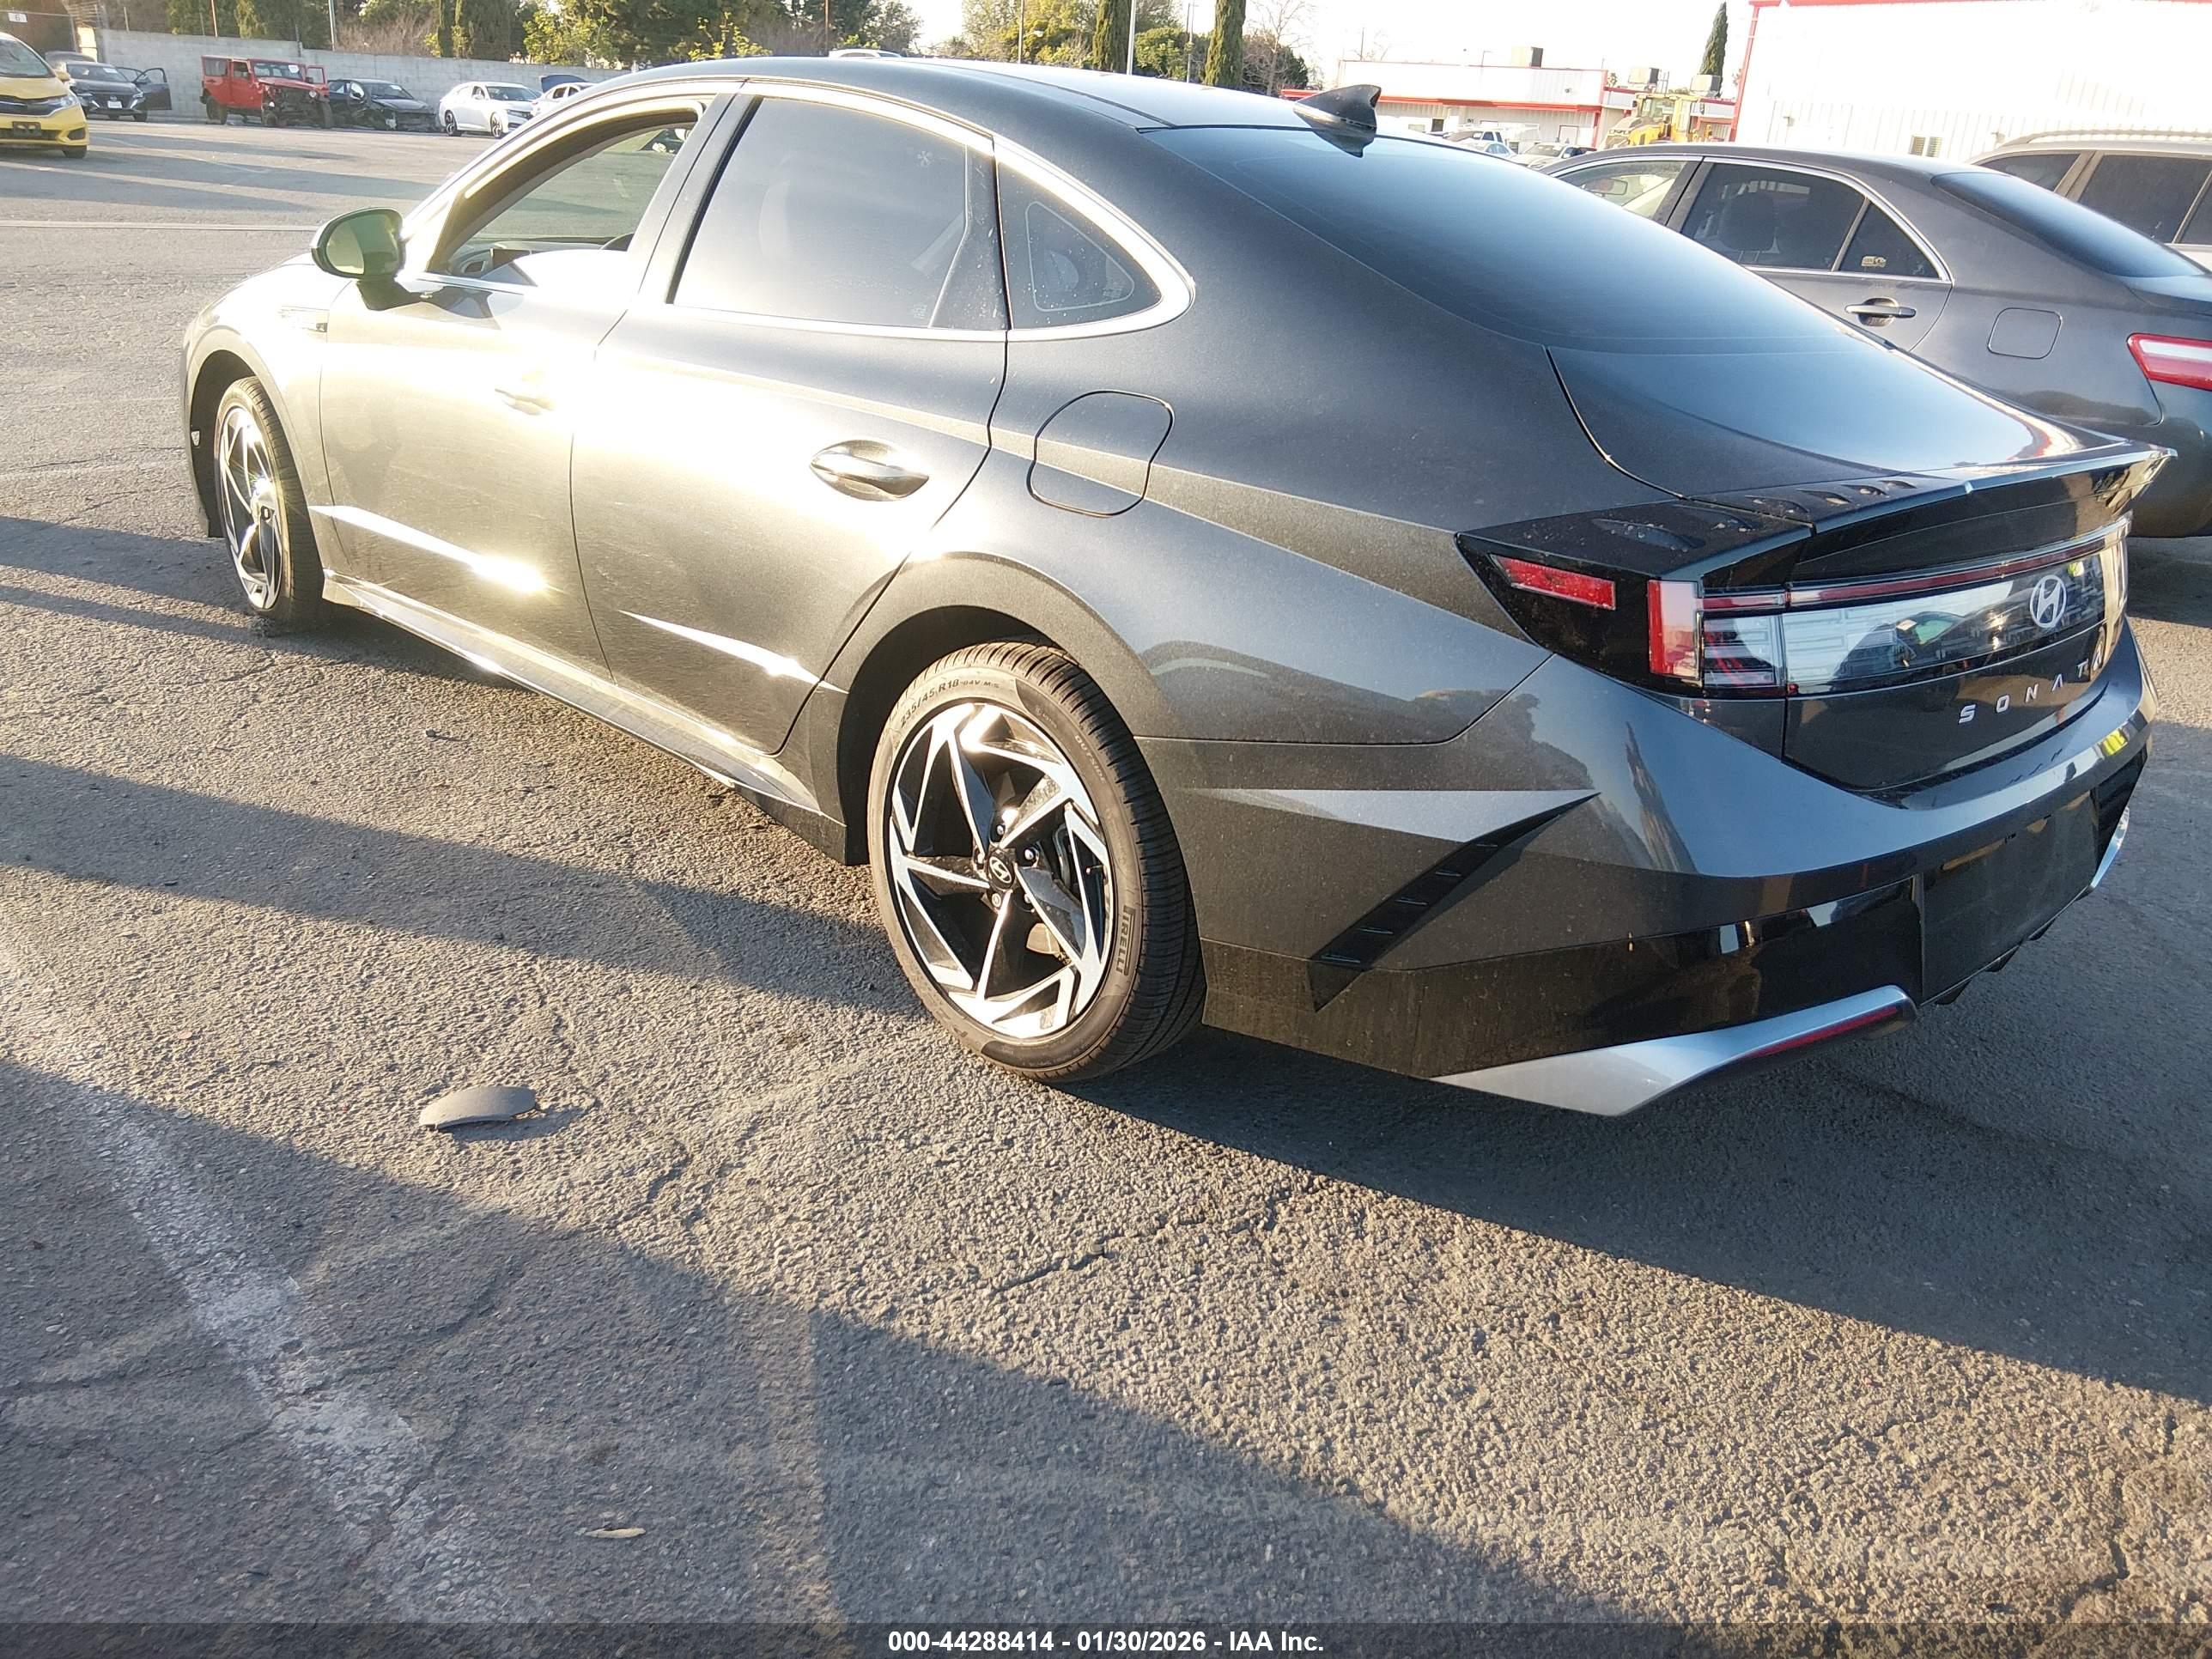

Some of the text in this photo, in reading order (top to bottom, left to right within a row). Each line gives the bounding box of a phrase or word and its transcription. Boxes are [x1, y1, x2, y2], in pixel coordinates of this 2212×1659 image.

[1958, 640, 2104, 725] SONATA
[1074, 734, 1106, 784] OUTSIDE
[1115, 904, 1137, 976] PIRELLI
